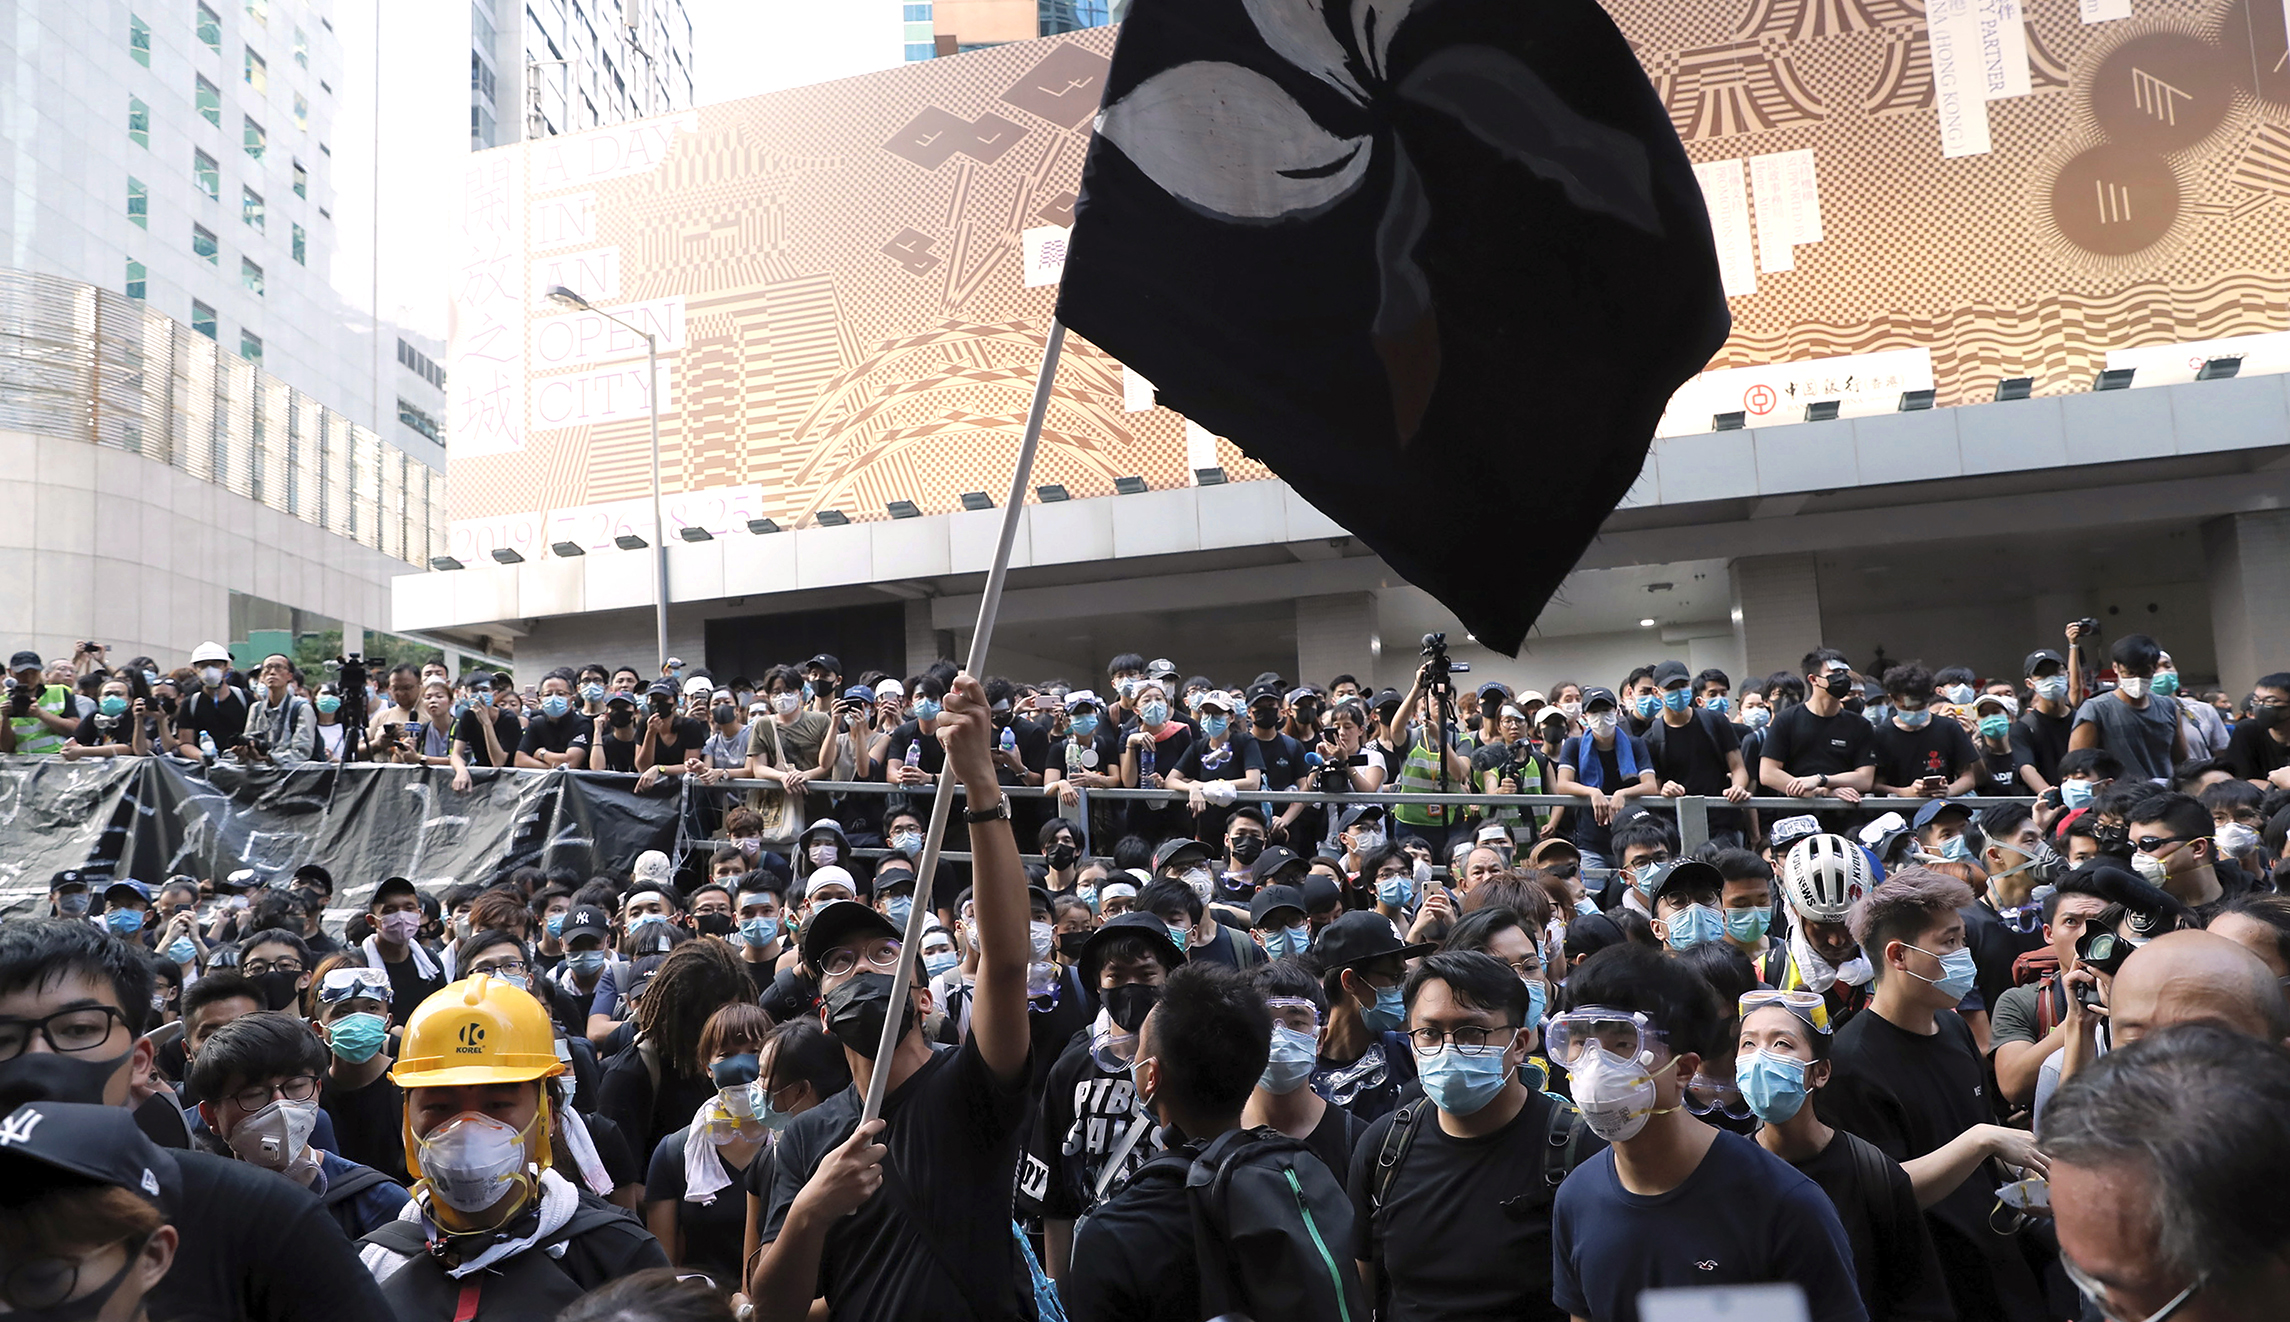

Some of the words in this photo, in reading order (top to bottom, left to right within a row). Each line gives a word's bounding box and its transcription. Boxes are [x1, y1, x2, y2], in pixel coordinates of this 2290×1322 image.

[1932, 30, 1957, 87] (HONG
[1981, 19, 2005, 93] PARTNER
[538, 144, 571, 185] A
[587, 120, 684, 176] DAY
[1754, 160, 1766, 192] Home
[1786, 155, 1803, 223] SUPPORTED
[538, 197, 589, 244] IN
[1714, 166, 1733, 238] PROMOTION
[1725, 241, 1739, 290] SUPPORT
[457, 156, 519, 445] 開放之城
[538, 253, 611, 303] AN
[538, 302, 676, 362] OPEN
[538, 366, 663, 423] CITY
[455, 521, 533, 563] 2019
[1797, 875, 1816, 907] NEWS
[456, 1046, 482, 1054] KOREL
